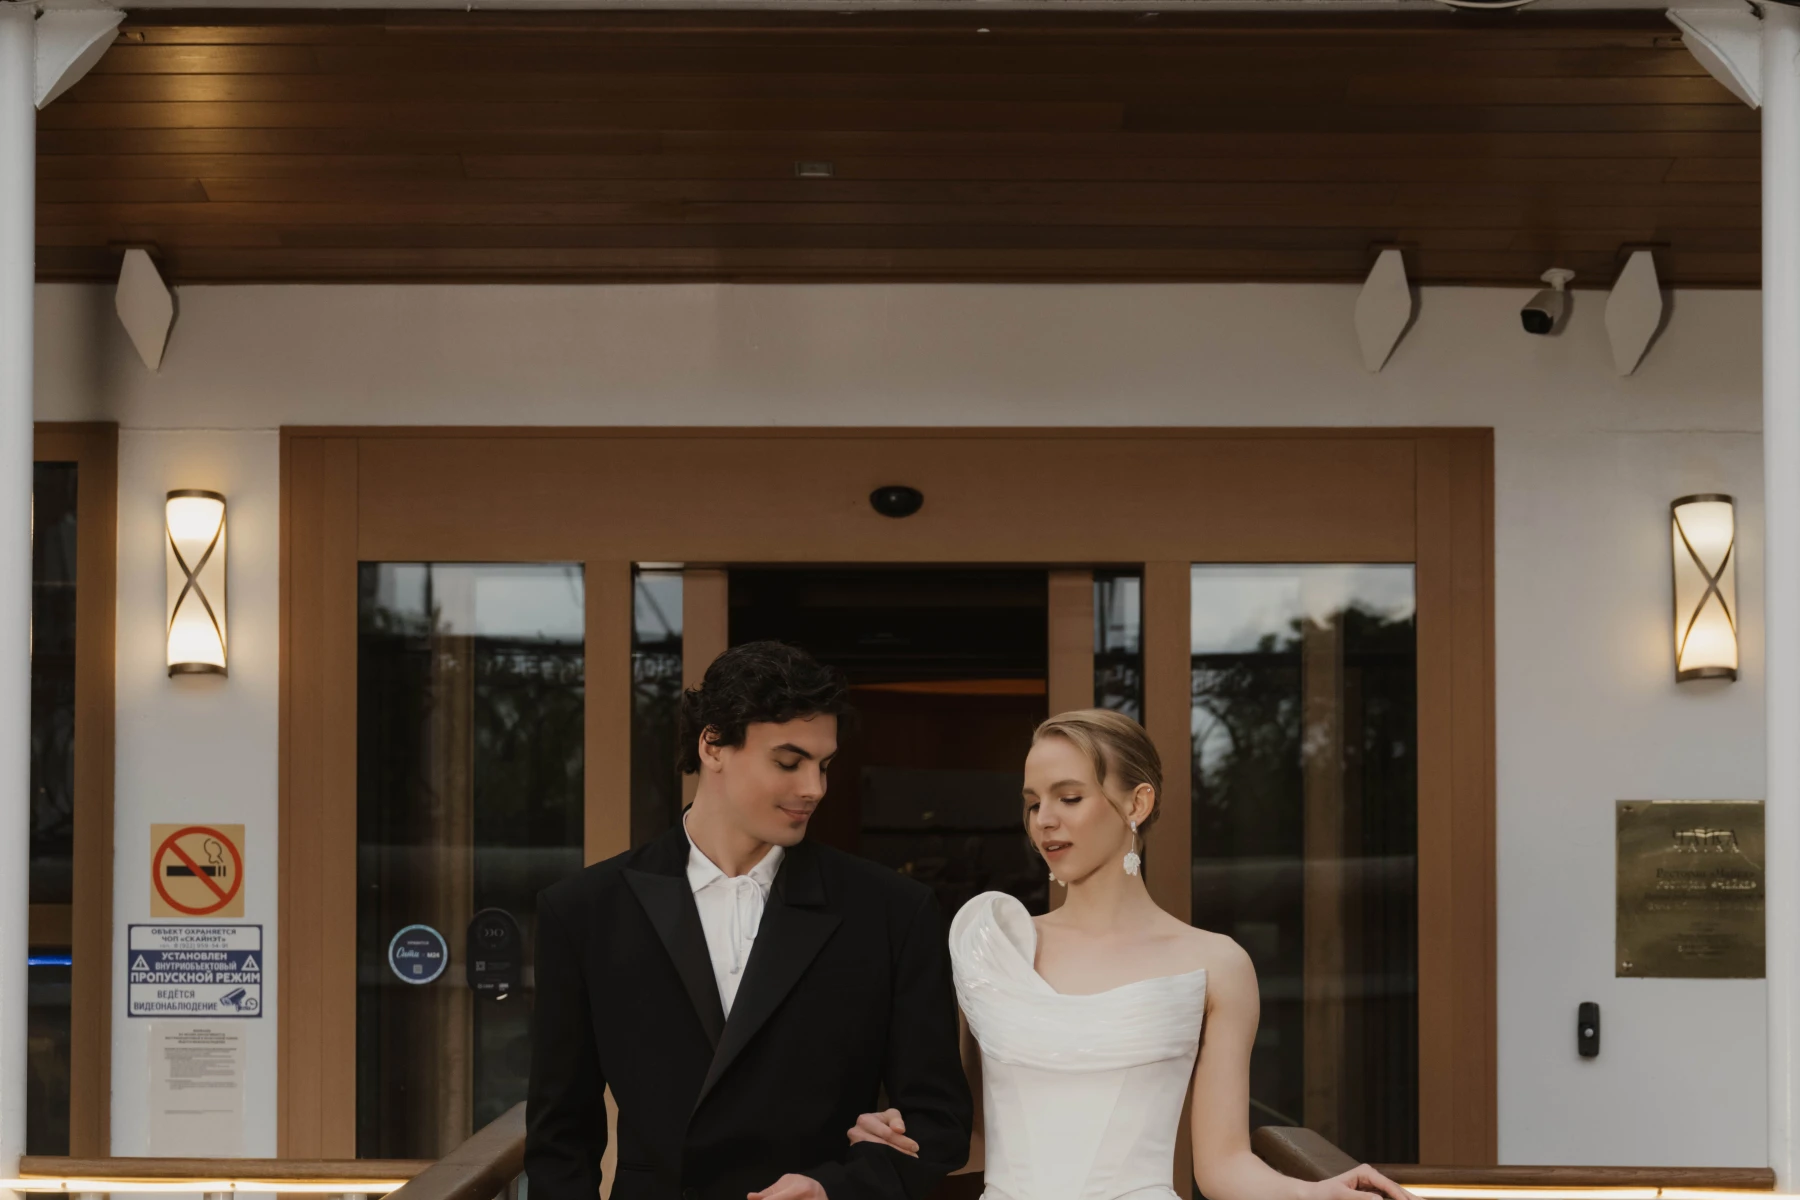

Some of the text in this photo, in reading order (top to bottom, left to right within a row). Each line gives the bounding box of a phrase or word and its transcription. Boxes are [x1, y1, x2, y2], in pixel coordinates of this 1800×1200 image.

[161, 952, 228, 961] УСТАНОВЛЕН
[155, 961, 237, 970] ВНУТРИОБЪЕКТОВЫЙ
[130, 971, 260, 983] ПРОПУСКНОЙ РЕЖИМ
[157, 988, 195, 1000] ВЕДЁТСЯ
[133, 1001, 218, 1012] ВИДЕОНАБЛЮДЕНИЕ
